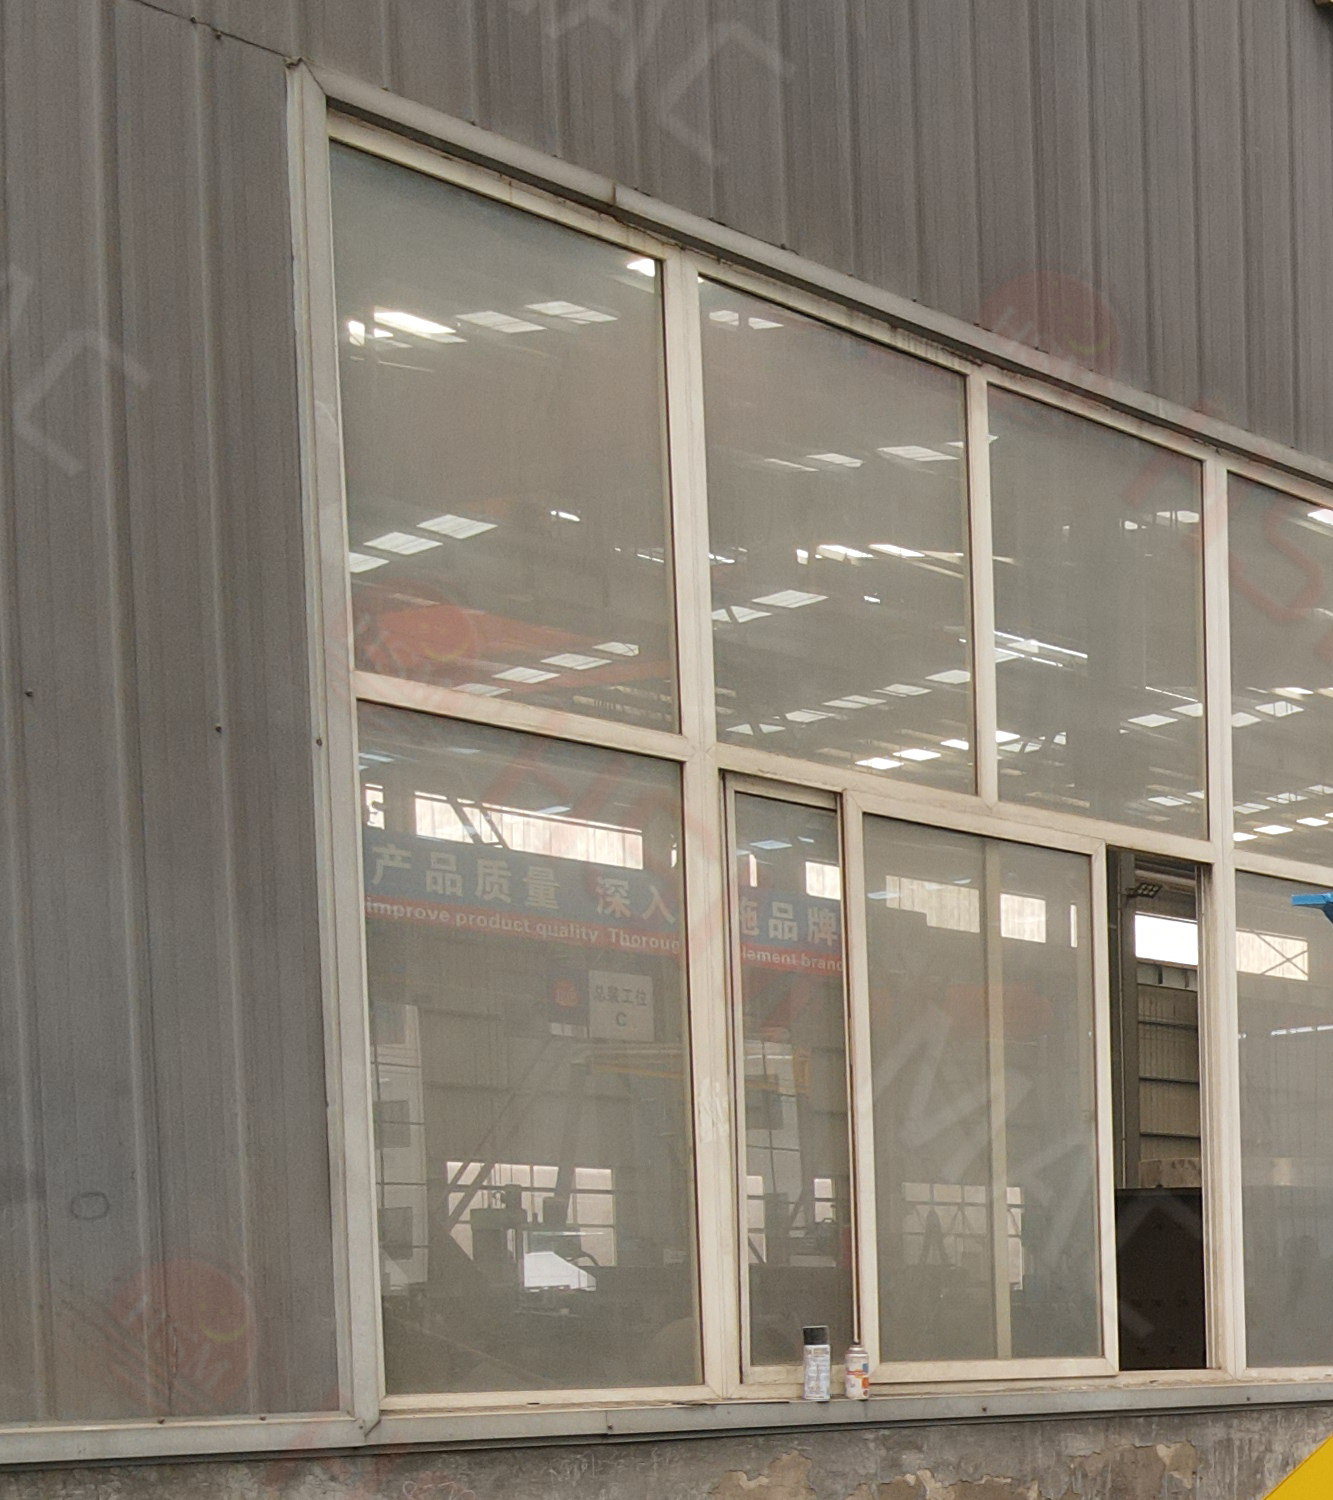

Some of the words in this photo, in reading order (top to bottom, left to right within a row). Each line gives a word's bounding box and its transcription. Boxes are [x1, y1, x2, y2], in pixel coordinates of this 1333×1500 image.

[371, 844, 561, 911] 产品质量
[596, 876, 677, 924] 深入
[366, 896, 450, 923] improve
[455, 911, 530, 936] product
[536, 920, 599, 944] quality
